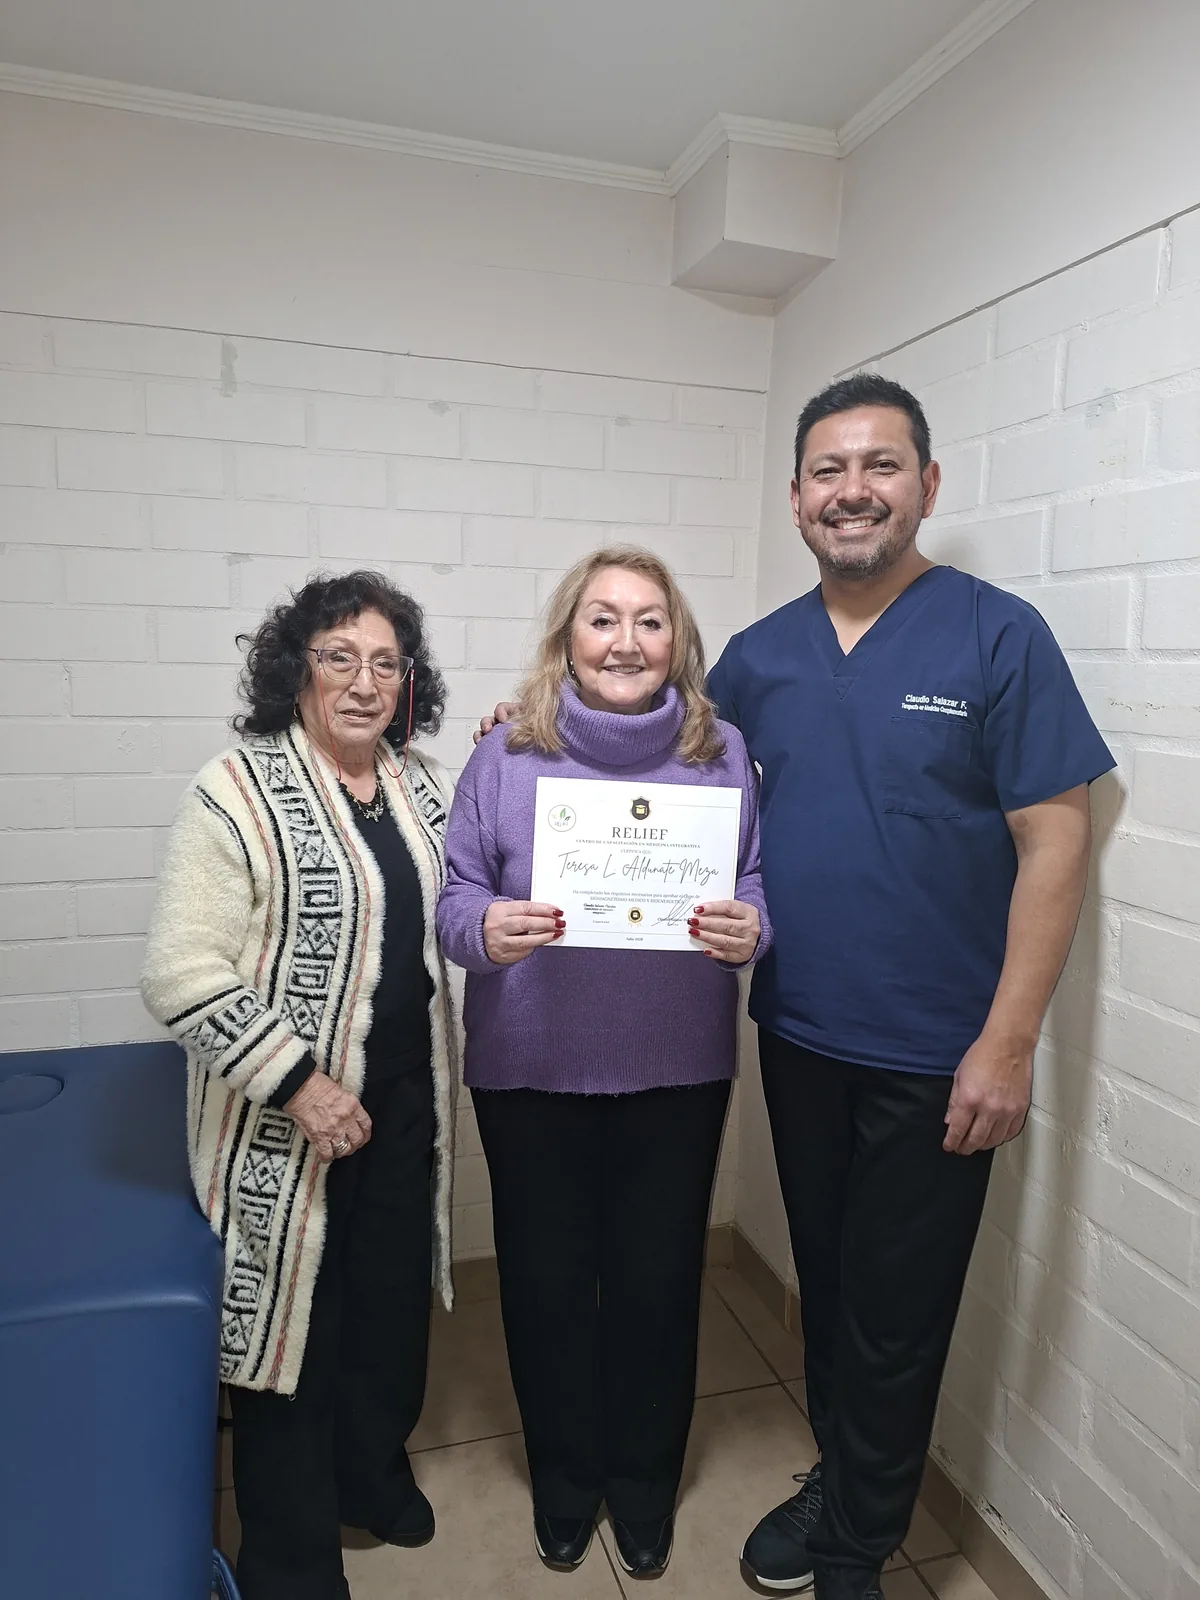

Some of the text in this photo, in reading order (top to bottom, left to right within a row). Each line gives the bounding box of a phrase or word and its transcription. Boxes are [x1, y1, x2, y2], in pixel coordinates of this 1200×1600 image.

[905, 694, 967, 709] Claudio Salazar F.
[611, 826, 669, 841] RELIEF
[558, 849, 599, 879] Teresa
[679, 858, 720, 887] Meza
